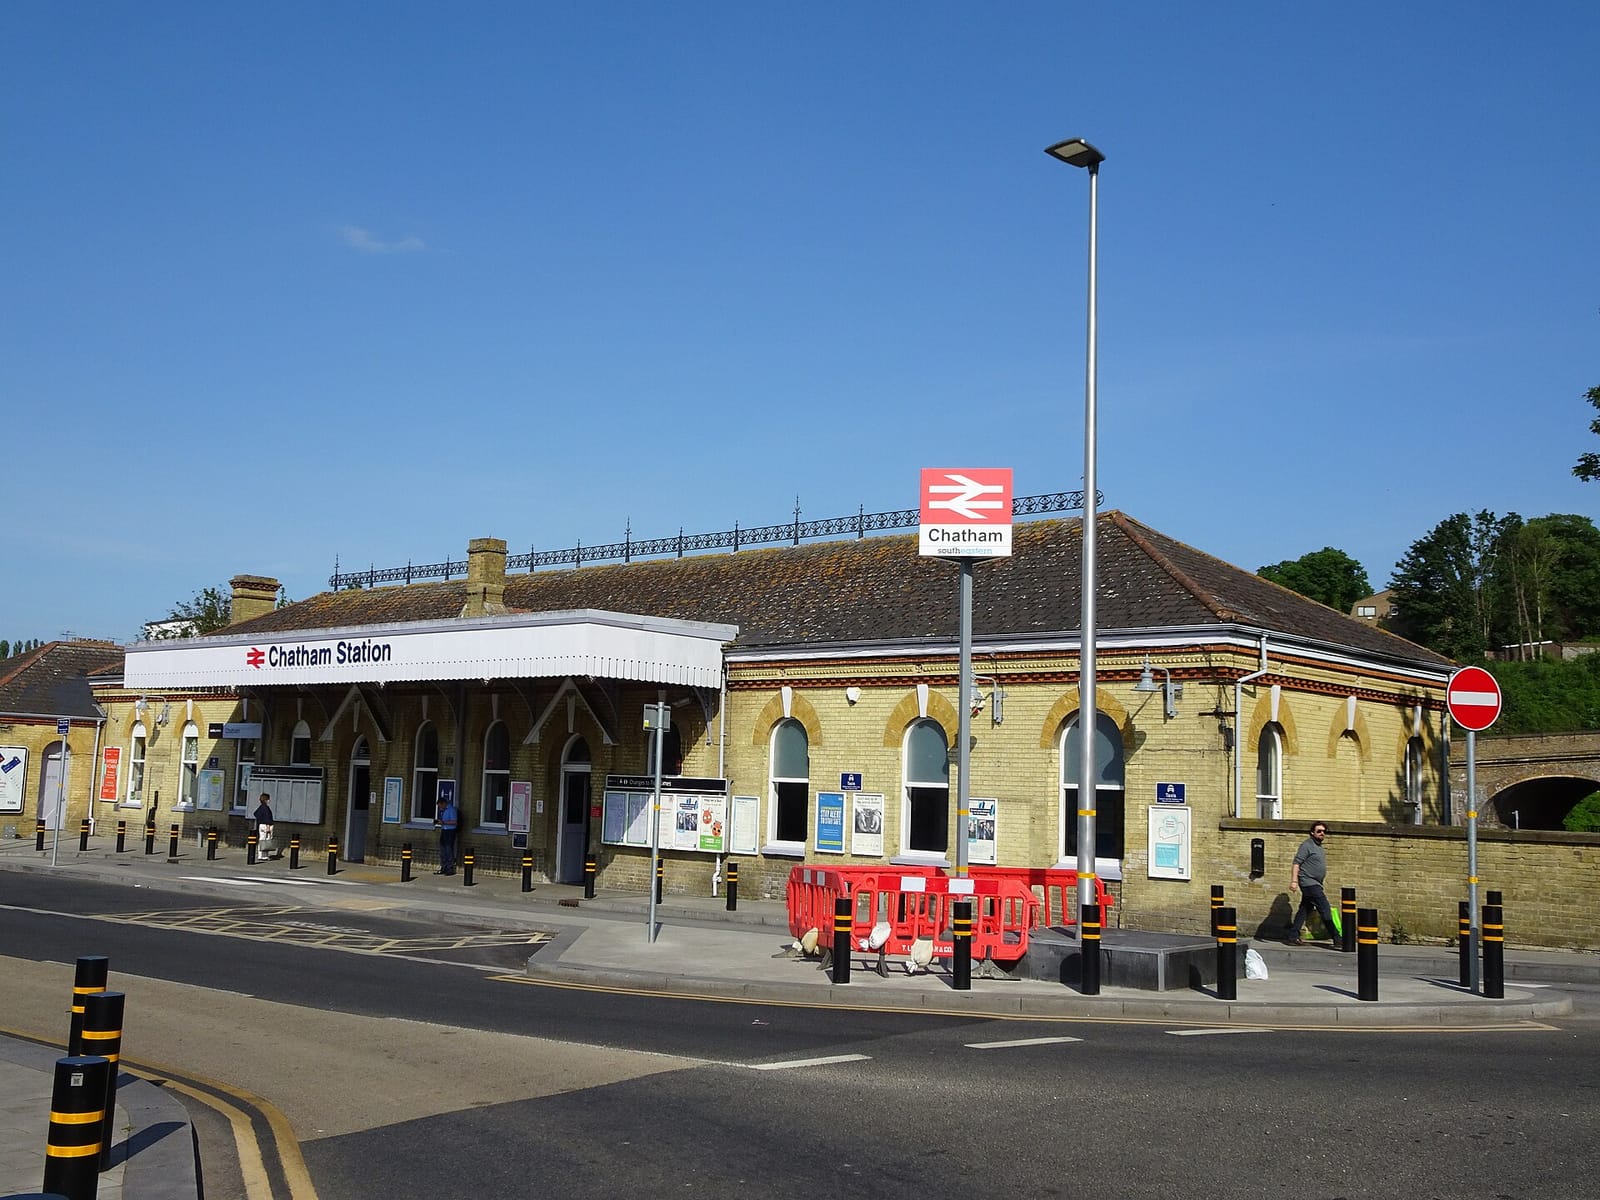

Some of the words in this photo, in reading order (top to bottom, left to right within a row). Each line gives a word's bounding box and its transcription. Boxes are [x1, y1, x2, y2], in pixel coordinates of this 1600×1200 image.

[928, 528, 1003, 542] Chatham
[937, 547, 993, 555] southeastern
[268, 645, 332, 667] Chatham
[336, 639, 391, 664] Station
